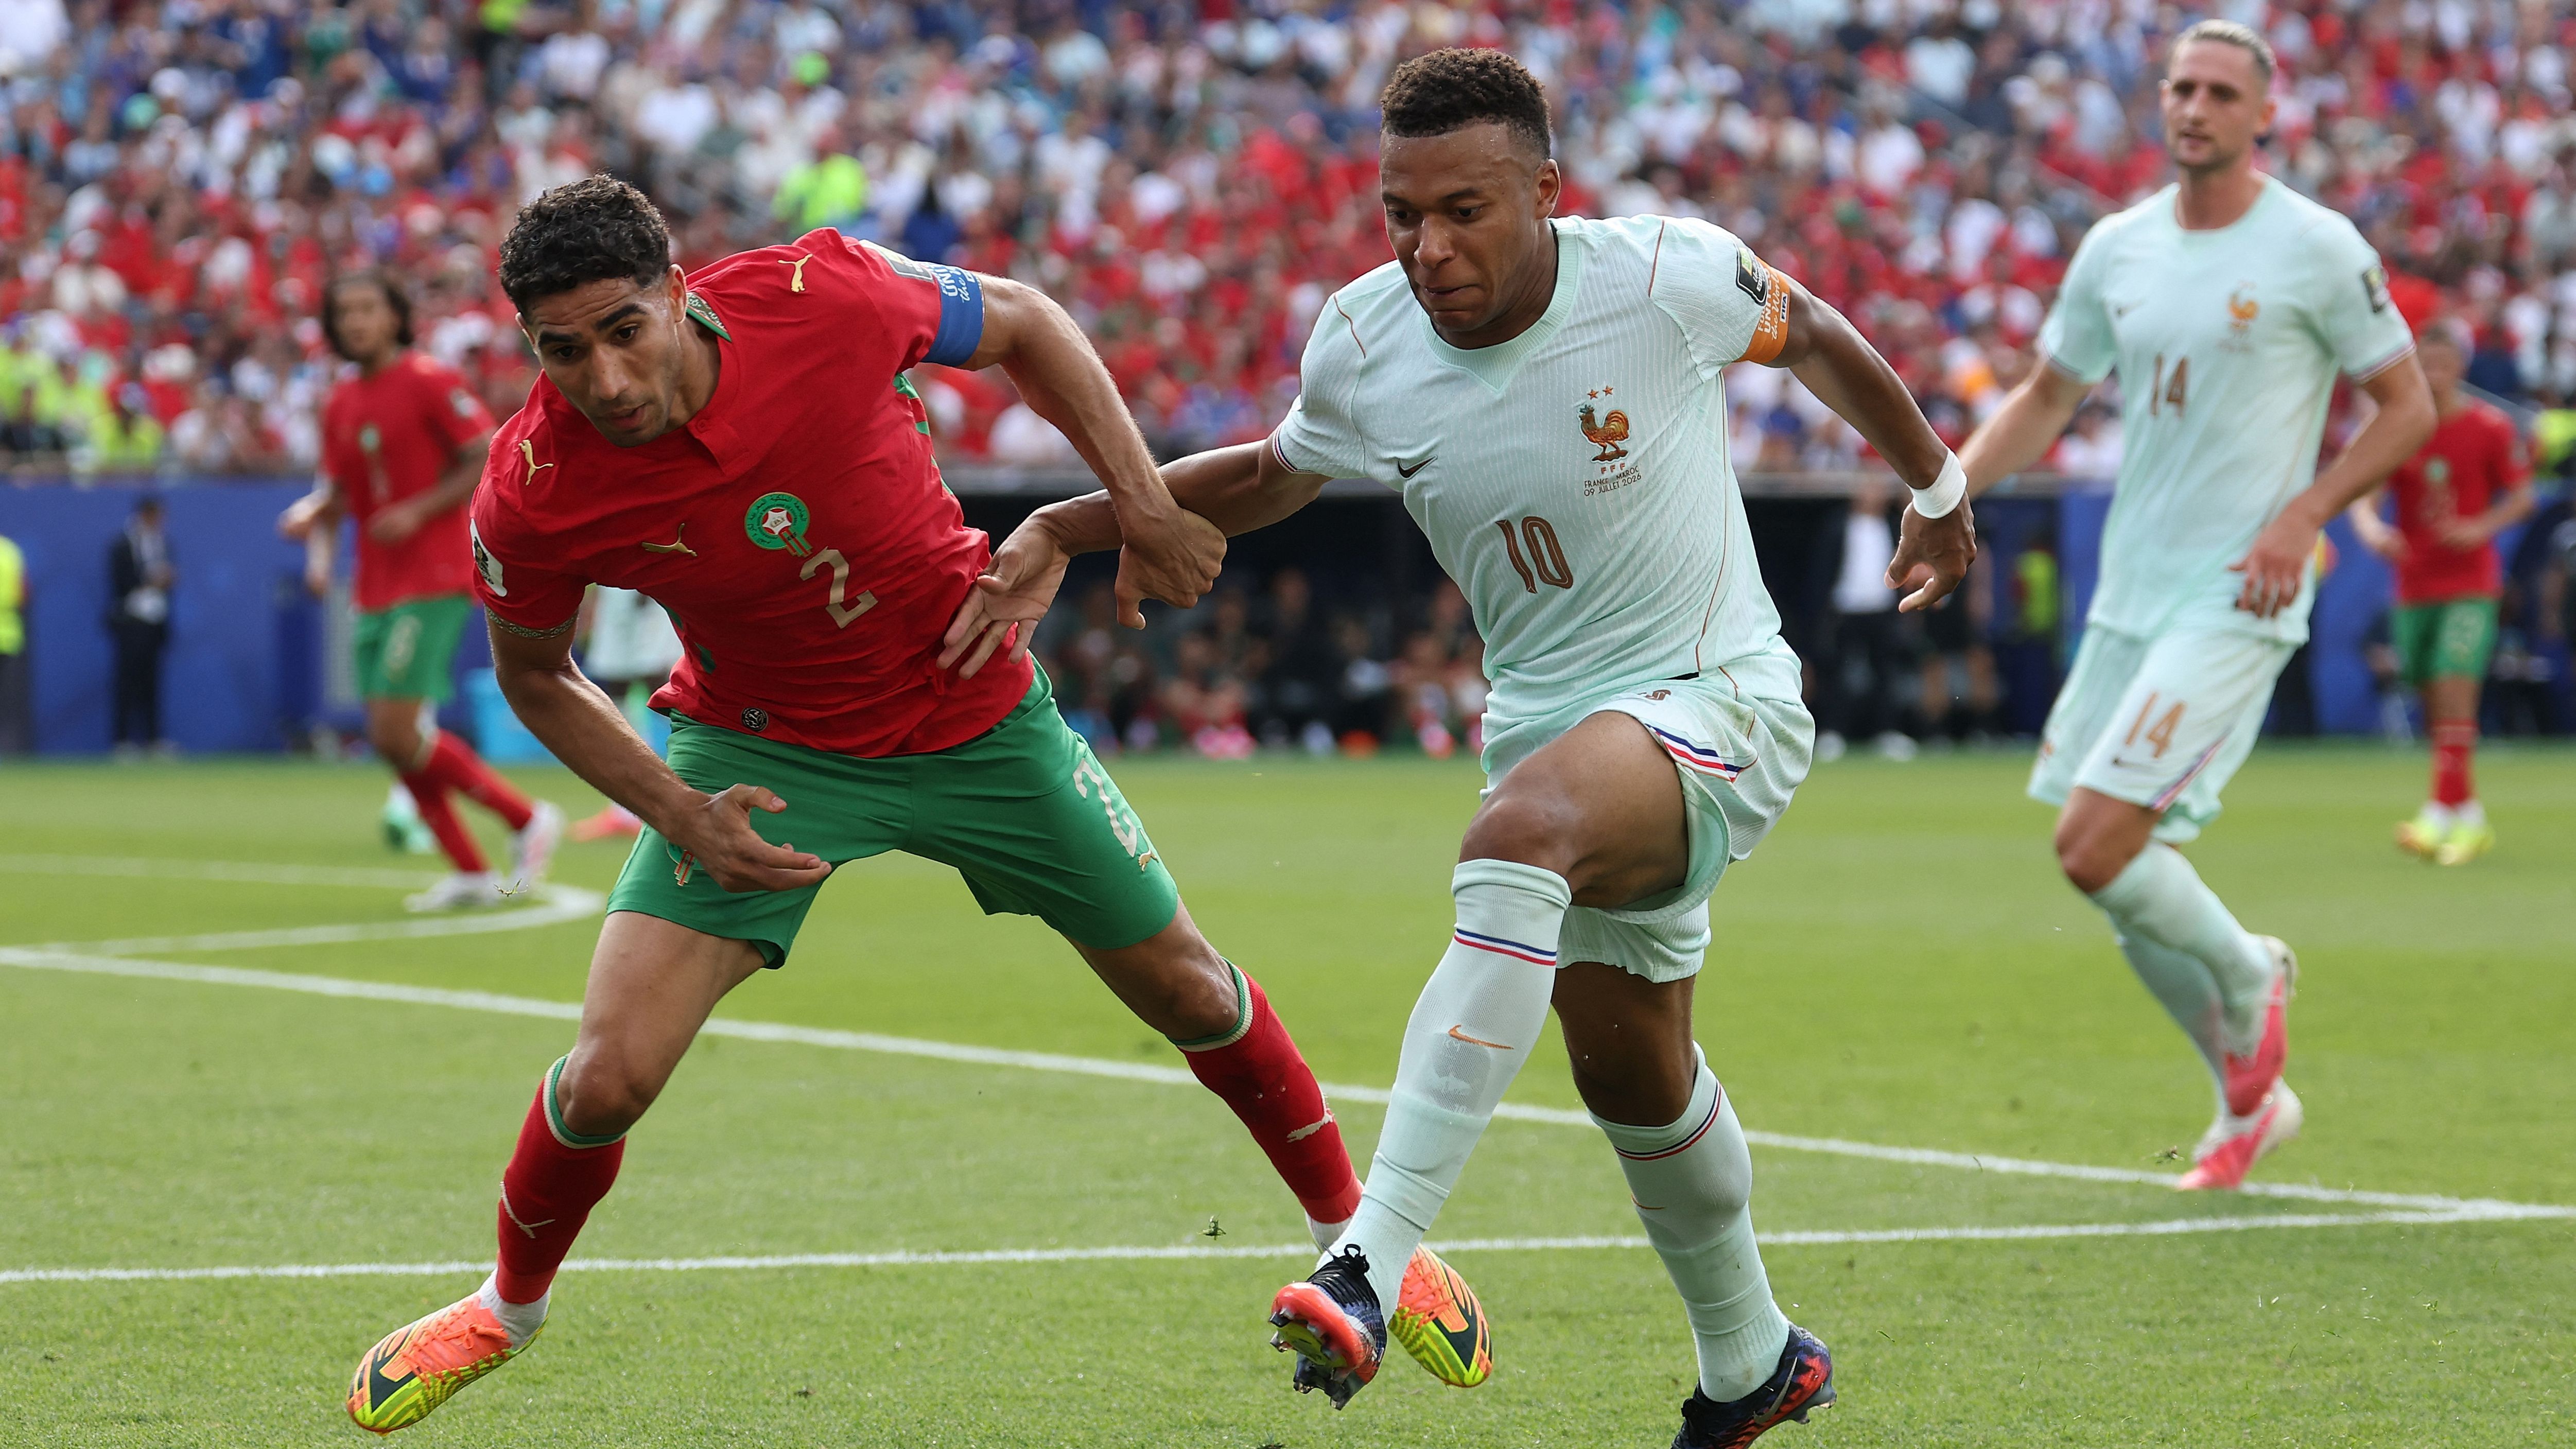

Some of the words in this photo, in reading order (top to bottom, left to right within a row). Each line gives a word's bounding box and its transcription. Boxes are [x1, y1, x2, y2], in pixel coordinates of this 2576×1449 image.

[2149, 352, 2189, 419] 14
[1584, 478, 1609, 488] FRANCE
[1616, 465, 1640, 480] MAROC
[1584, 488, 1595, 497] 09
[1598, 481, 1620, 494] JUILLET
[1622, 473, 1642, 486] 2026
[799, 546, 878, 629] 2
[1495, 516, 1573, 594] 10
[2125, 691, 2186, 759] 14
[1072, 758, 1138, 858] 2
